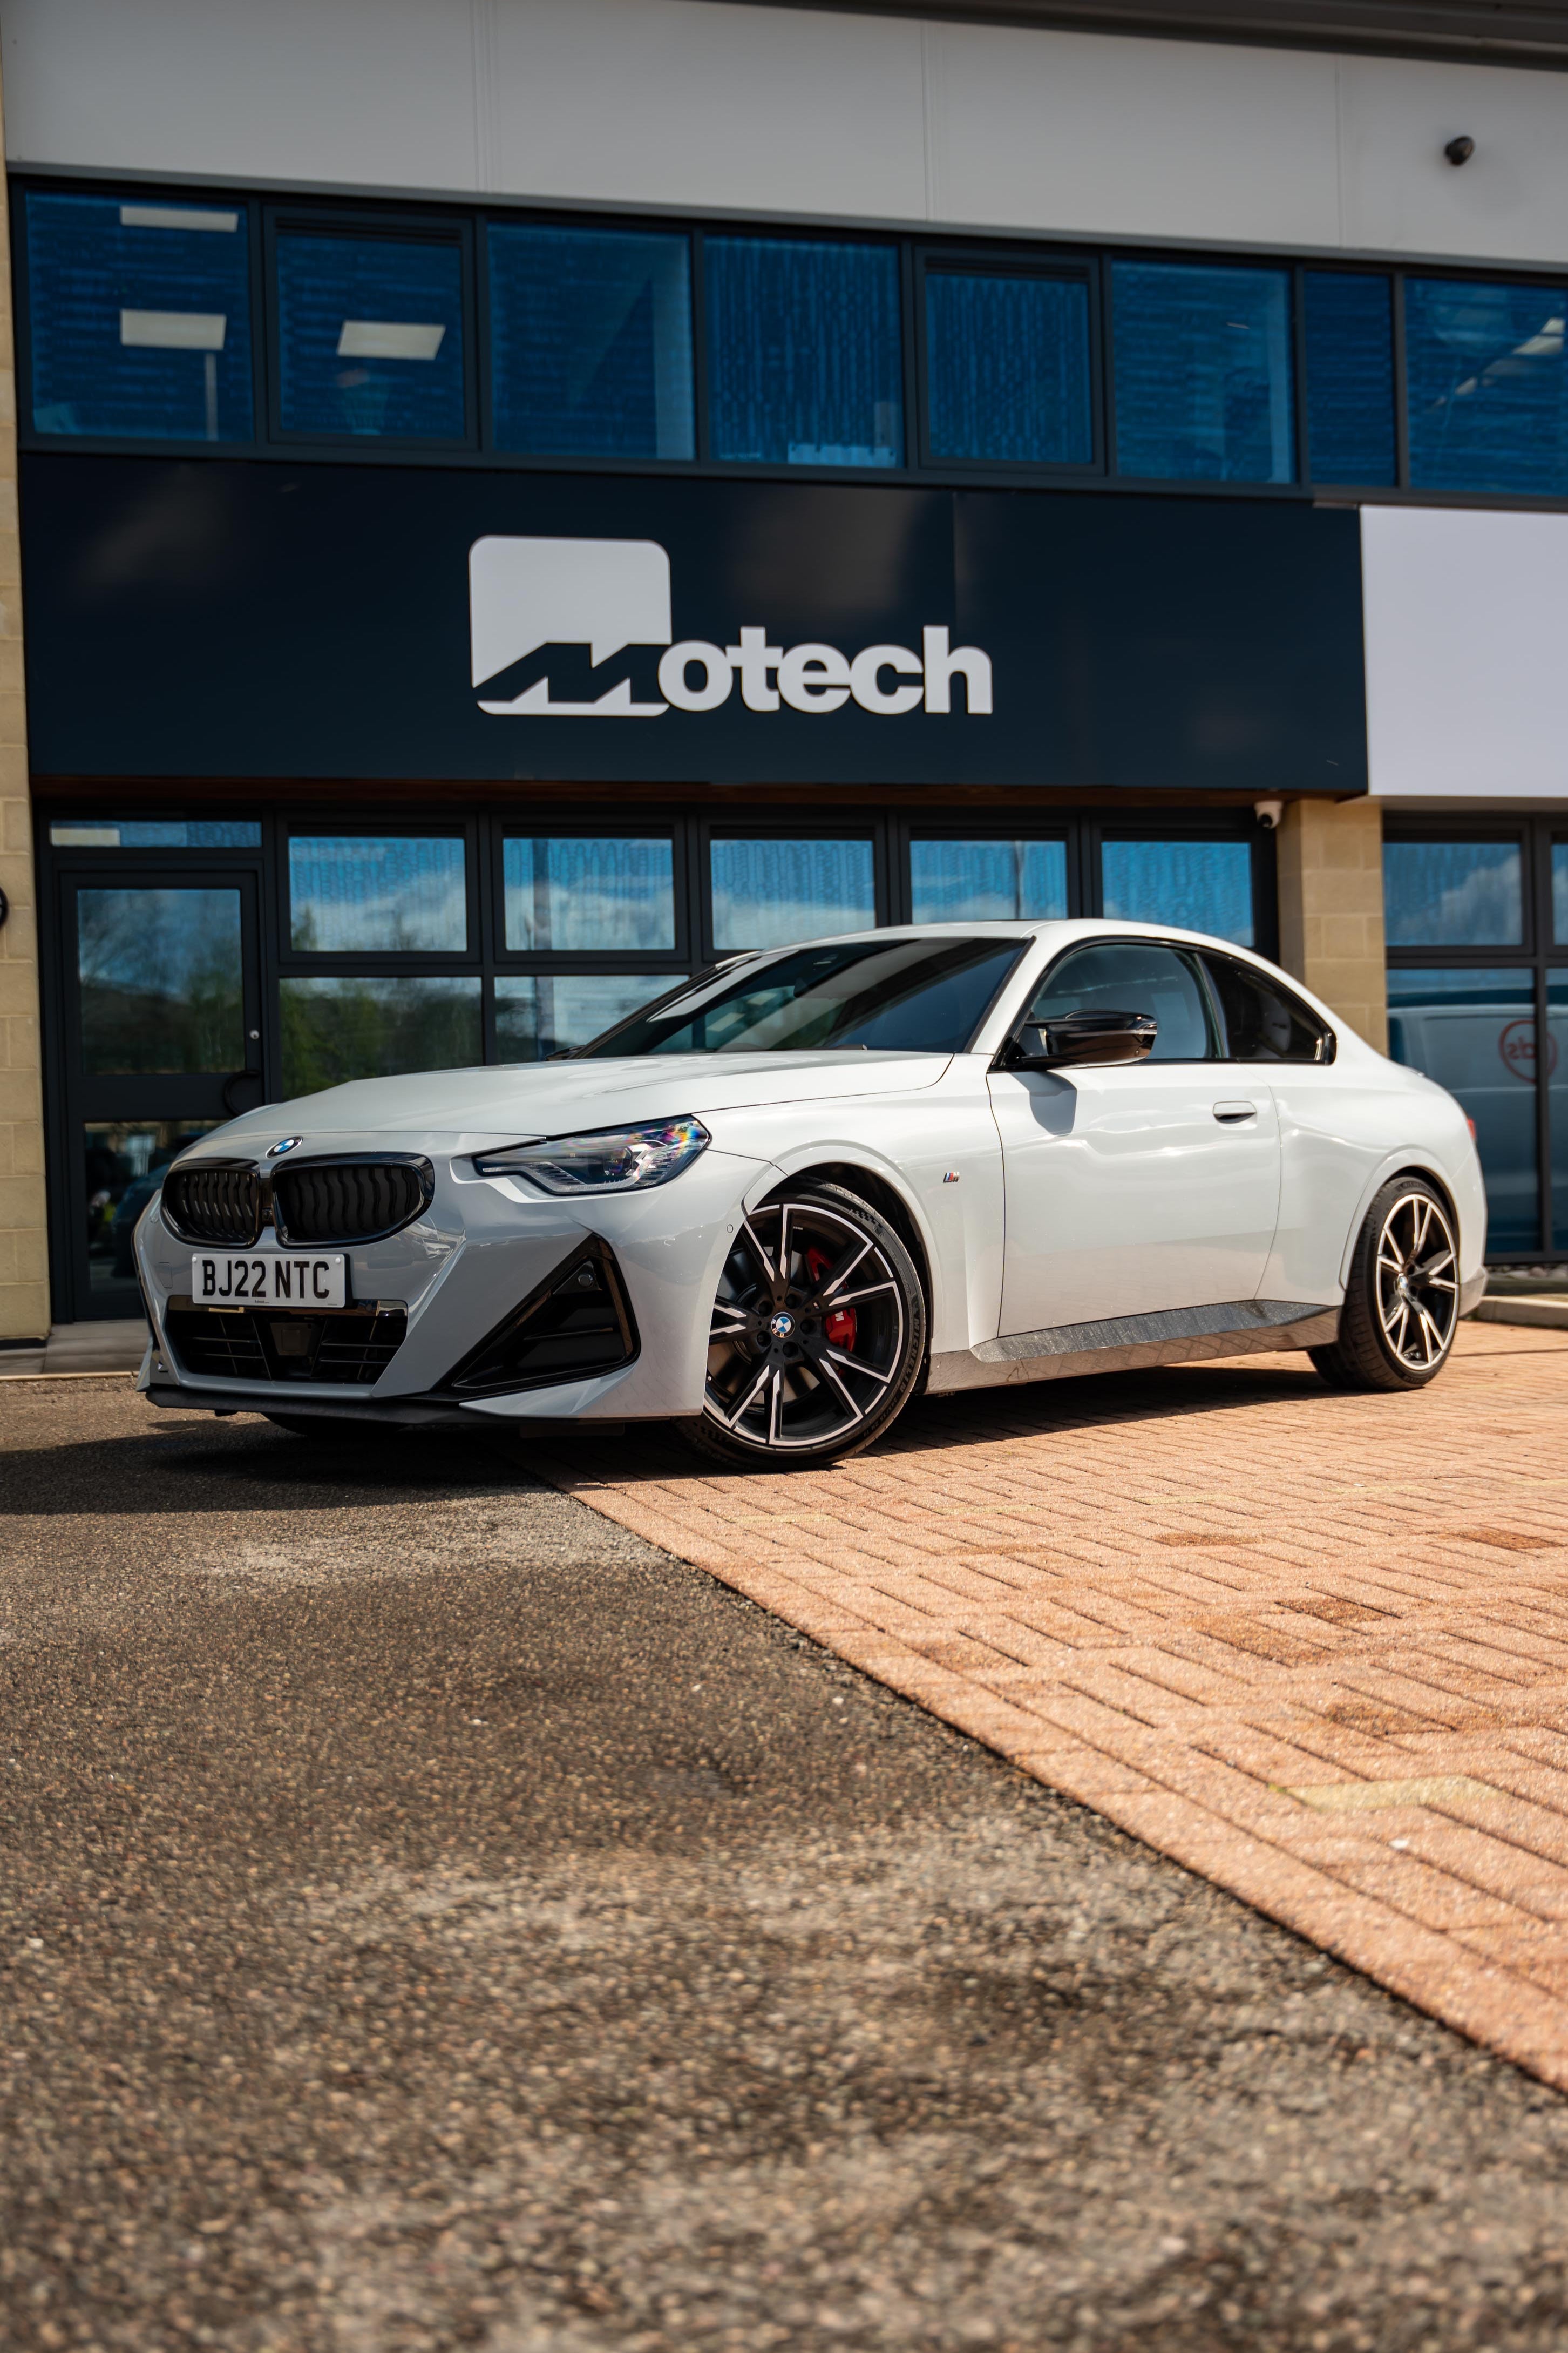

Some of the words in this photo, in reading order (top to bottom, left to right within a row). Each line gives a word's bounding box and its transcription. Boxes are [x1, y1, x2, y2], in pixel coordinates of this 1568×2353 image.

[202, 1260, 267, 1297] BJ22
[275, 1261, 330, 1299] NTC
[898, 1316, 919, 1393] MICHELIN
